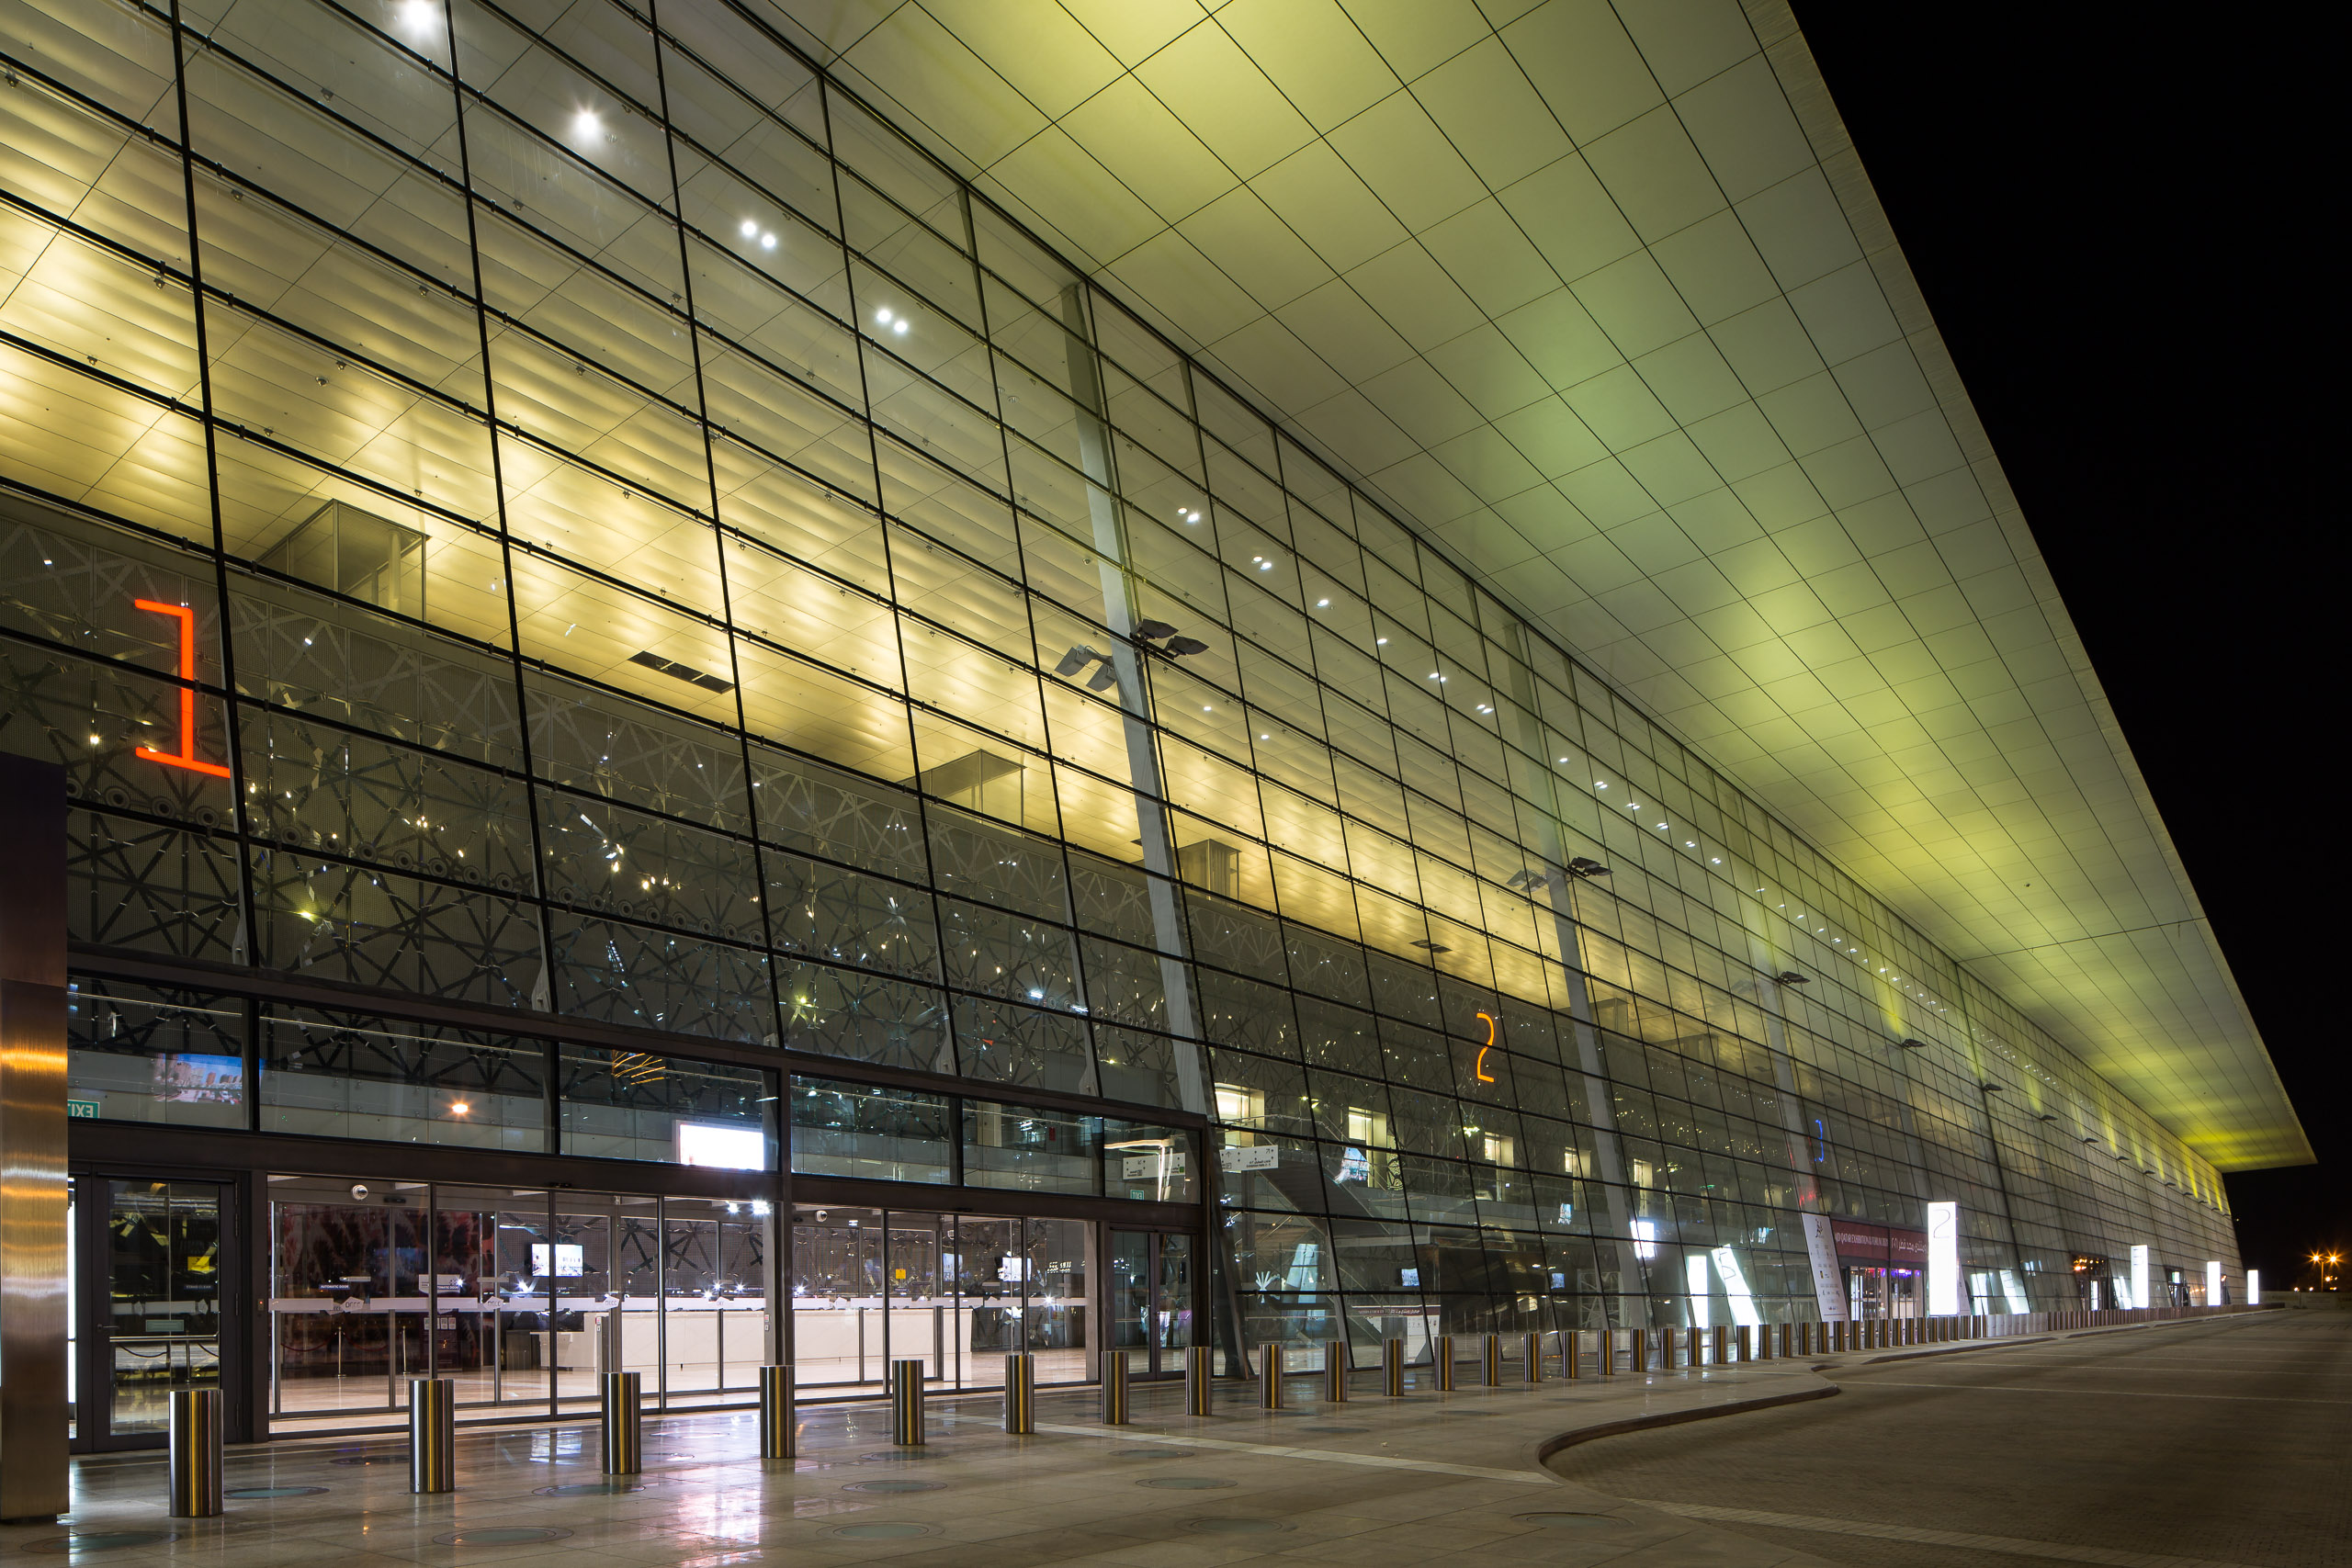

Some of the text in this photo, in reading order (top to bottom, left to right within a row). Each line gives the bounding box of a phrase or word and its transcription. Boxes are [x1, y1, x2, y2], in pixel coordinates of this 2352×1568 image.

[135, 599, 230, 779] 1
[1476, 1012, 1495, 1083] 2
[1933, 1208, 1951, 1239] 2
